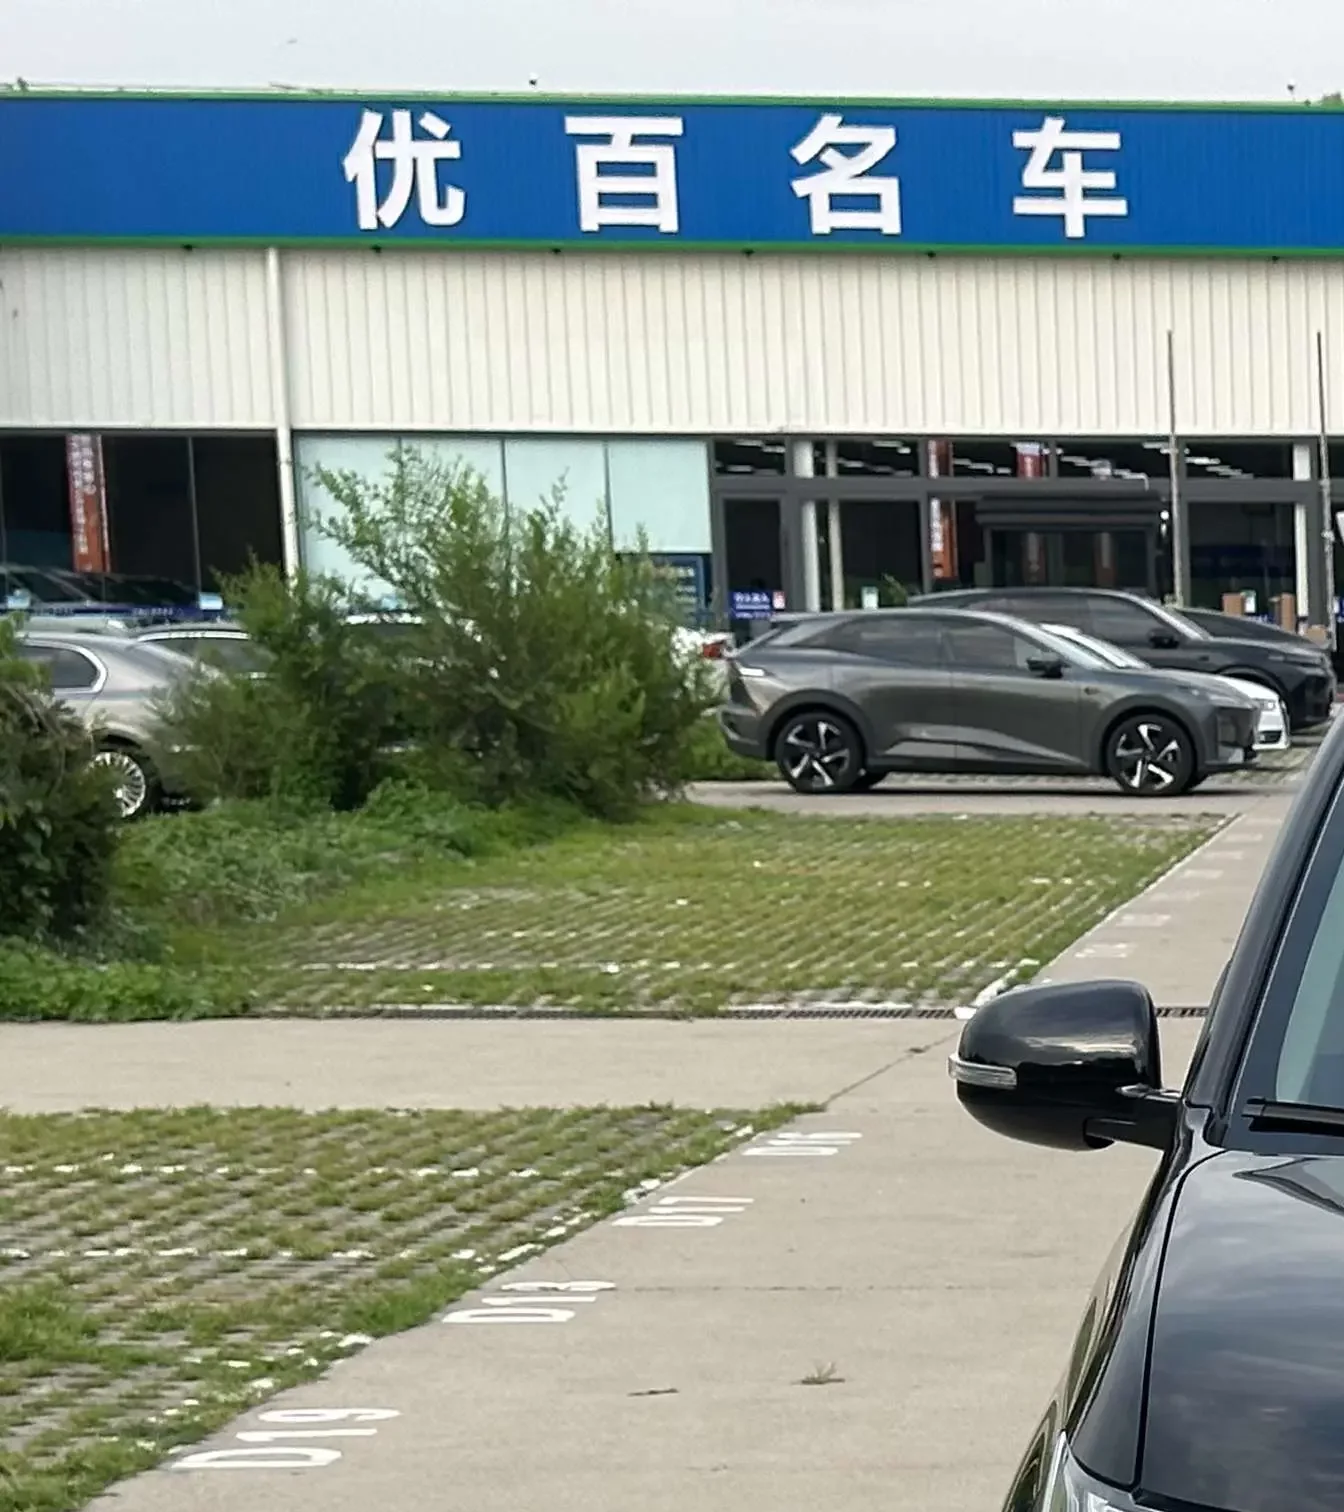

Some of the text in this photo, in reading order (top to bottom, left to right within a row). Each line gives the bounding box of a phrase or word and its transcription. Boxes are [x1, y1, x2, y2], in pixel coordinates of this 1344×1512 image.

[343, 108, 1128, 240] 优百名车
[171, 1408, 402, 1469] D19
